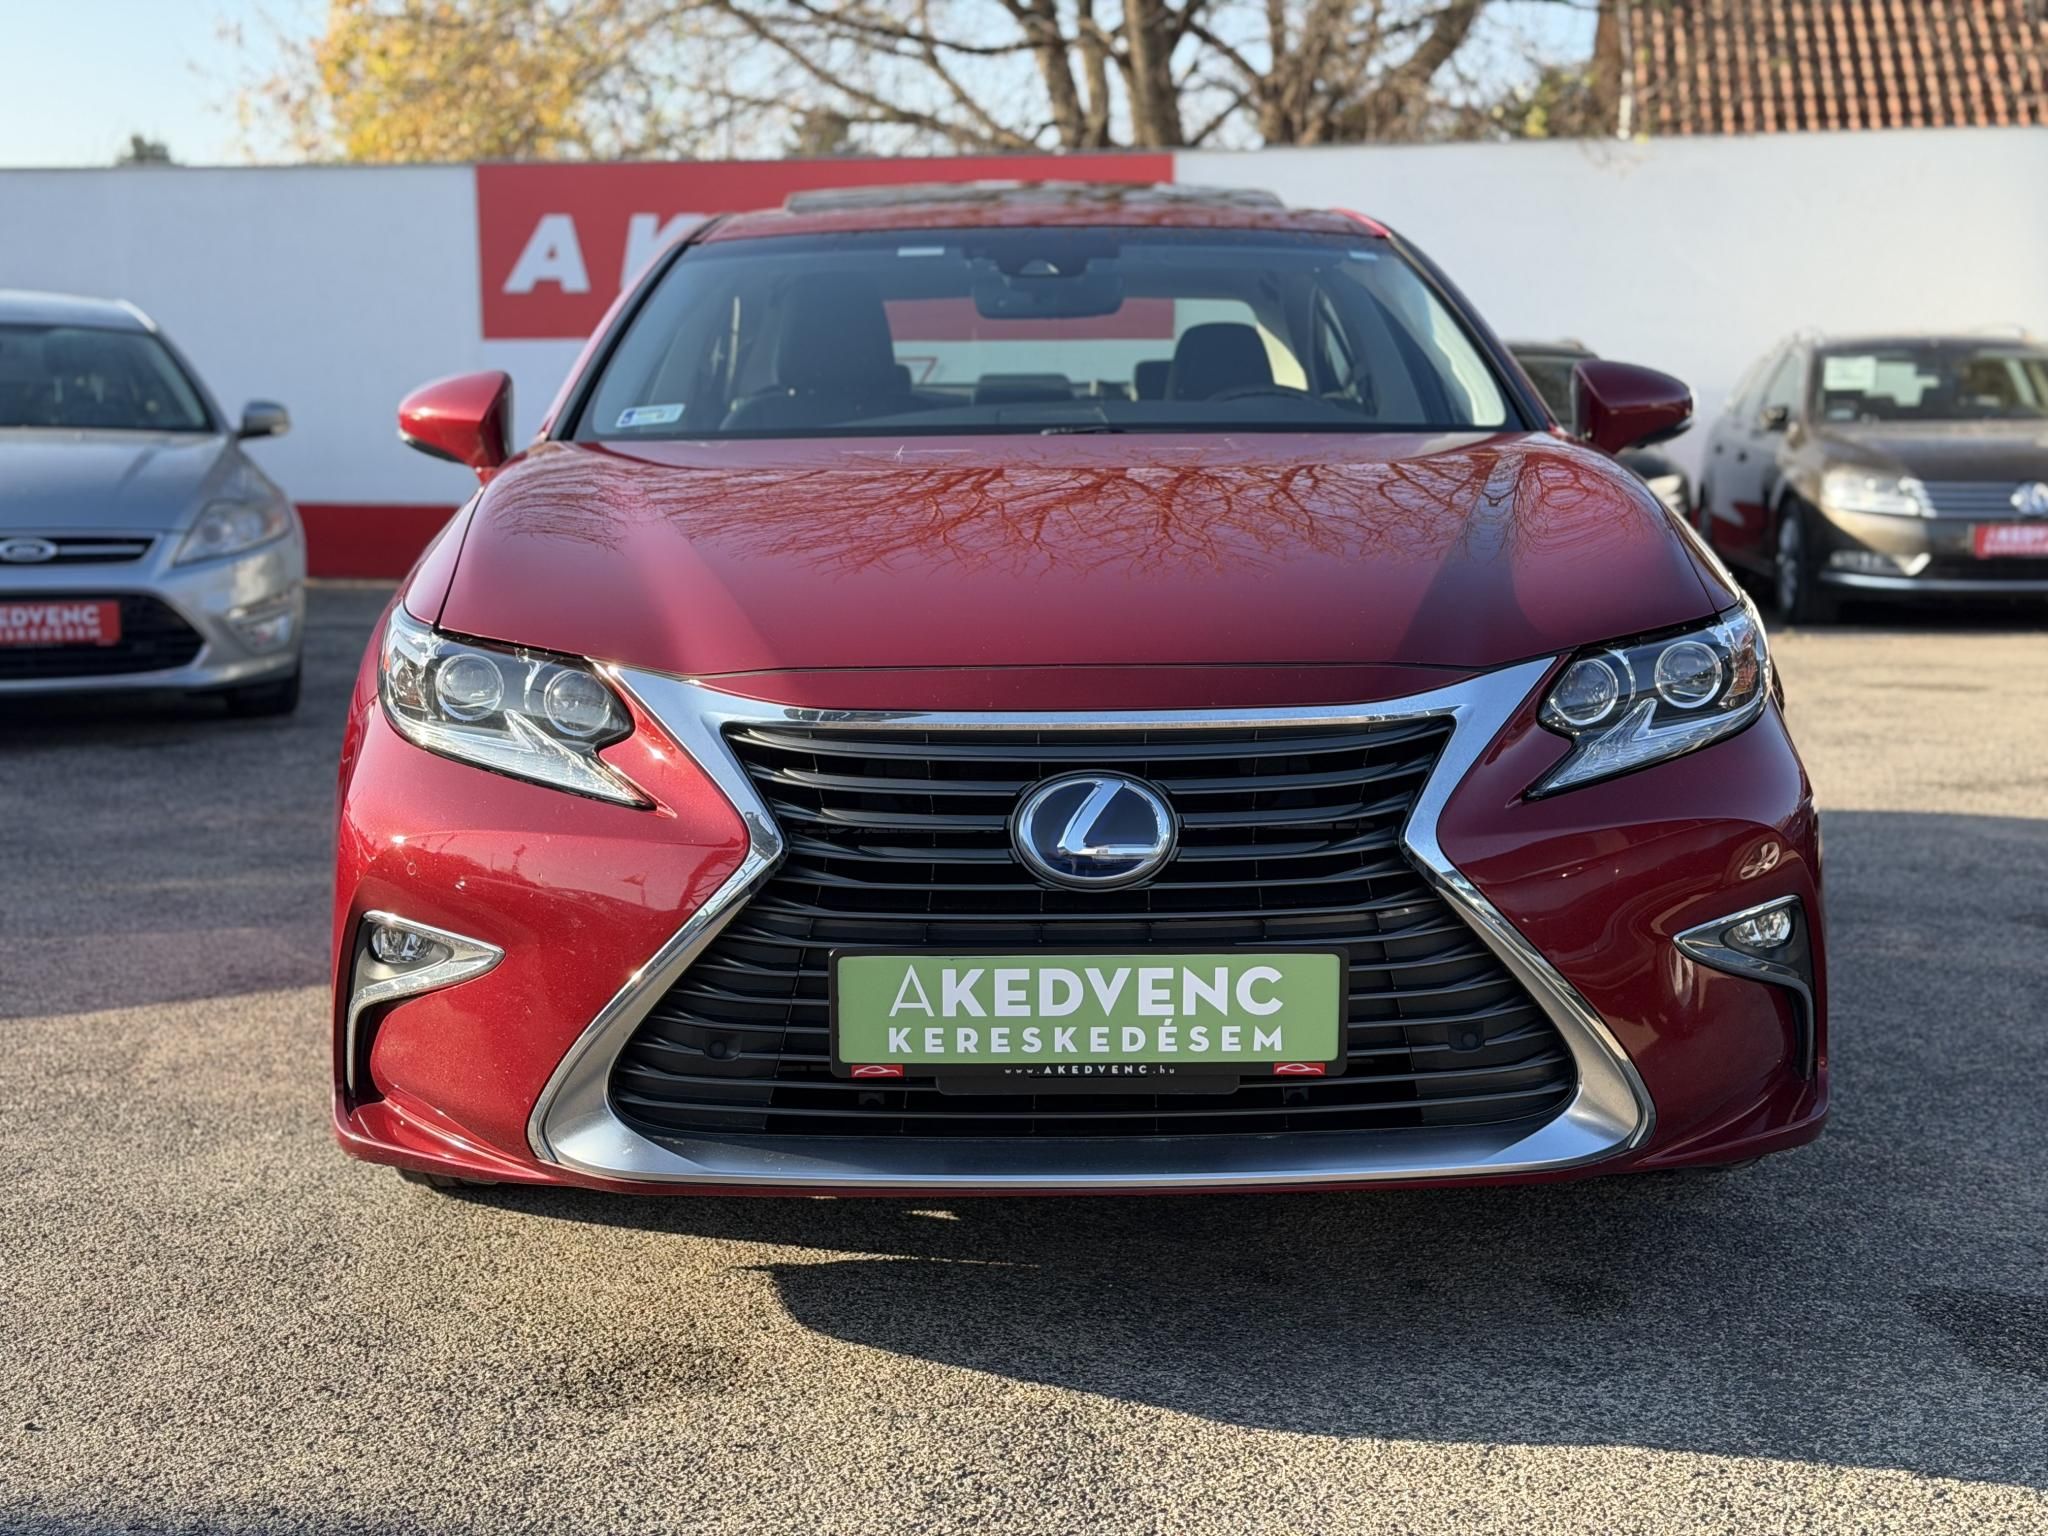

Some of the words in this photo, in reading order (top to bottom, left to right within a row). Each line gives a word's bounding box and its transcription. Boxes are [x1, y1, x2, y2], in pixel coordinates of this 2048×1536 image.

[888, 964, 1284, 1017] AKEDVENC
[888, 1018, 1283, 1054] KERESKEDÉSEM
[1004, 1064, 1176, 1076] www.AKEDVENC.hu
